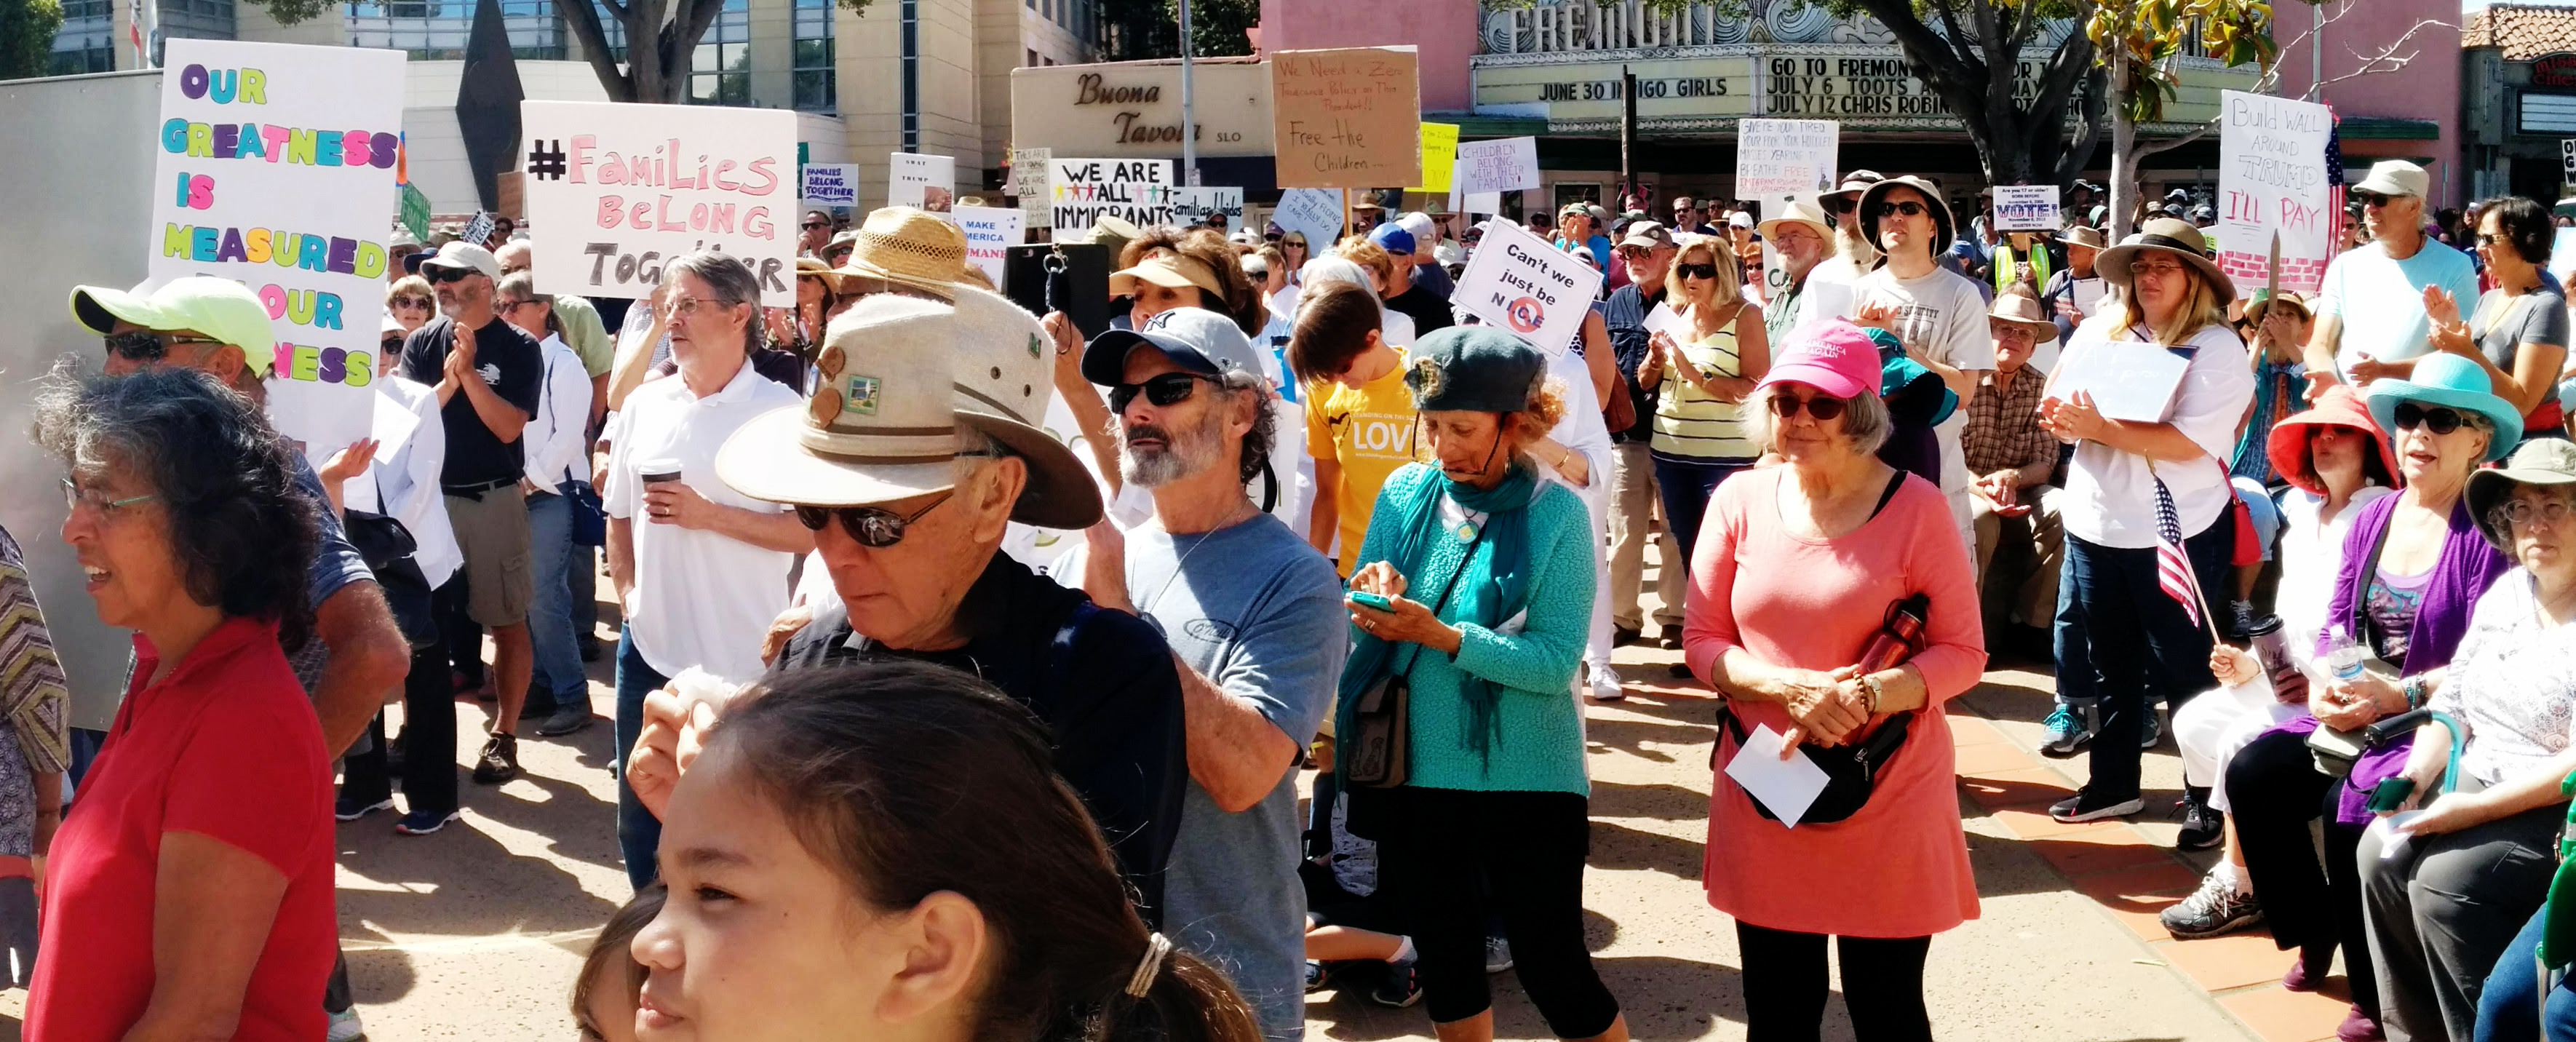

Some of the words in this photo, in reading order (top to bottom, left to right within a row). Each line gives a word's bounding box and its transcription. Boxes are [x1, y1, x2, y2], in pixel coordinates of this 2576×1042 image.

[1279, 59, 1303, 76] We
[1310, 57, 1345, 77] Need
[1369, 61, 1404, 76] Zero
[1771, 58, 1795, 76] GO
[1805, 58, 1826, 76] TO
[1838, 59, 1912, 76] FREMON
[180, 64, 267, 104] OUR
[1074, 73, 1160, 105] Buona
[1538, 82, 1577, 100] JUNE
[1583, 81, 1604, 100] 30
[1611, 81, 1666, 99] INIGO
[1677, 78, 1727, 97] GIRLS
[1767, 77, 1813, 94] JULY
[1821, 78, 1833, 94] 6
[1847, 78, 1907, 95] TOOTS
[1767, 96, 1813, 113] JULY
[1819, 96, 1835, 113] 12
[1840, 96, 1893, 114] CHRIS
[1898, 97, 1955, 114] ROBIN
[1800, 122, 1825, 133] TIRED
[2285, 110, 2321, 132] WALL
[162, 118, 398, 168] GREATNESS
[1217, 132, 1241, 142] SLO
[1289, 121, 1324, 147] Free
[1332, 119, 1365, 148] the
[1463, 145, 1515, 159] CHILDREN
[2251, 135, 2299, 156] AROUND
[806, 167, 842, 176] FAMILIES
[1315, 152, 1368, 172] Children
[1470, 168, 1492, 179] WITH
[1497, 165, 1524, 177] THEIR
[1477, 156, 1514, 168] BELONG
[809, 177, 843, 187] BELONG
[1033, 175, 1045, 184] ARE
[1062, 162, 1102, 183] WE
[1113, 162, 1160, 183] ARE
[177, 172, 215, 210] IS
[806, 186, 854, 196] TOGETHER
[1019, 186, 1037, 196] ALL
[1097, 183, 1132, 203] ALL
[1996, 204, 2058, 218] VOTE!
[2280, 197, 2321, 236] PAY
[966, 220, 996, 230] MAKE
[163, 223, 386, 279] MEASURED
[1507, 244, 1549, 274] Can't
[1551, 269, 1574, 288] we
[1500, 269, 1533, 293] just
[1536, 287, 1556, 306] be
[258, 284, 343, 330] OUR
[1807, 338, 1846, 356] AMERICA
[1808, 347, 1838, 359] AGAIN
[1353, 421, 1412, 452] LOV
